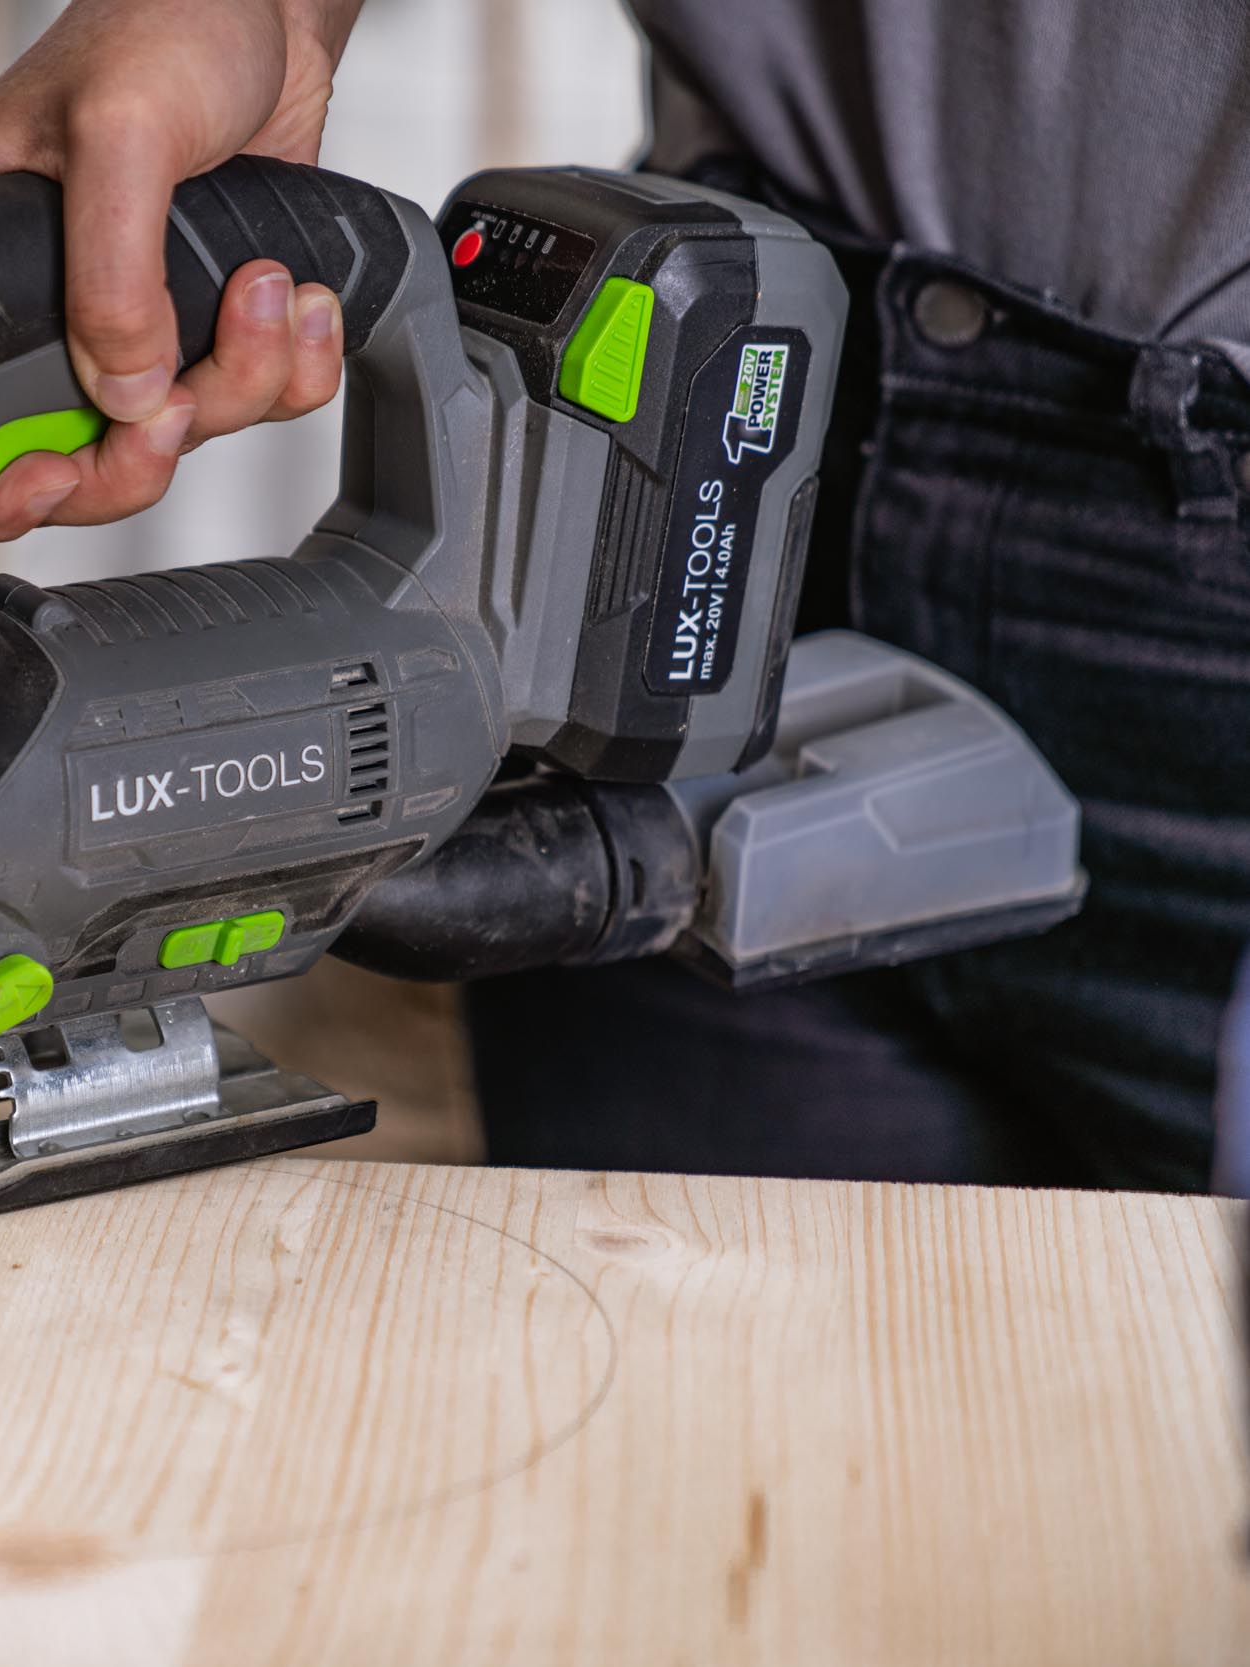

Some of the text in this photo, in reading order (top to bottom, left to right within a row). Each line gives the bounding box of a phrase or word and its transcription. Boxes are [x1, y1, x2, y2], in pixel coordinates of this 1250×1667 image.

[741, 350, 758, 386] 20V
[748, 350, 772, 428] POWER
[761, 349, 786, 429] SYSTEM
[668, 479, 723, 680] LUX-TOOLS
[715, 523, 736, 580] 4.0Ah
[706, 593, 725, 631] 20V
[700, 633, 718, 680] max.
[89, 744, 326, 822] LUX-TOOLS
